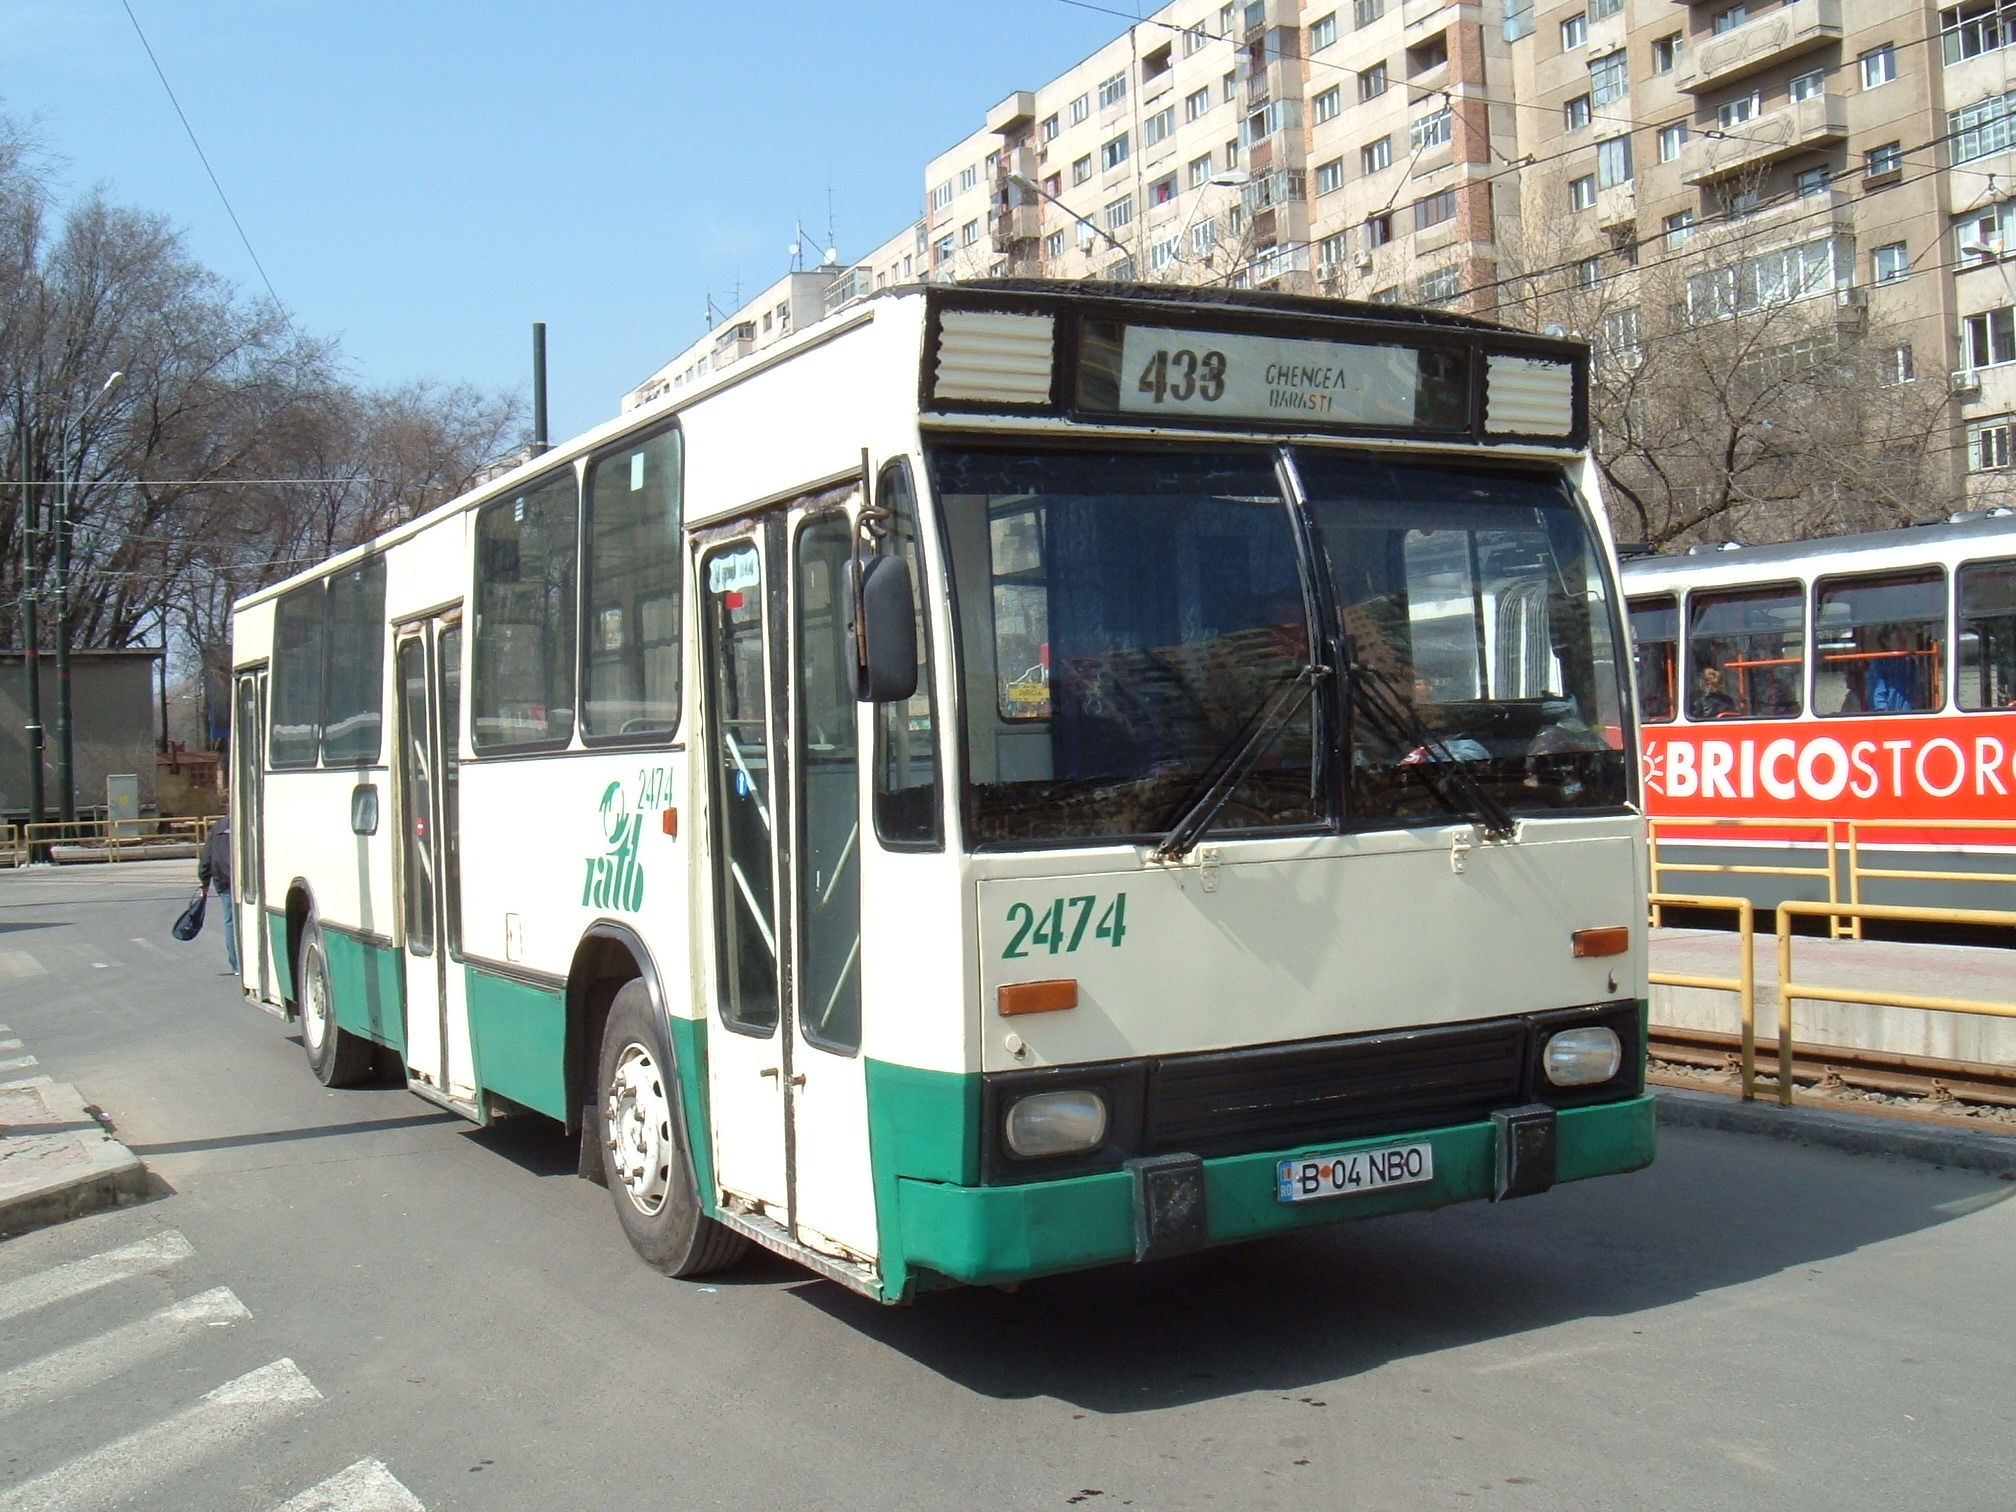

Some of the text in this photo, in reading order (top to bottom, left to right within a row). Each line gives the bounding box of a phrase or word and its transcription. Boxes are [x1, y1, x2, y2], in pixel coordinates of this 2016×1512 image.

[1138, 349, 1227, 403] 433
[637, 767, 674, 810] 2474
[1666, 737, 2016, 801] BRICOSTOR
[1001, 892, 1127, 959] 2474
[1332, 1157, 1361, 1189] 04
[1370, 1148, 1422, 1184] NBO
